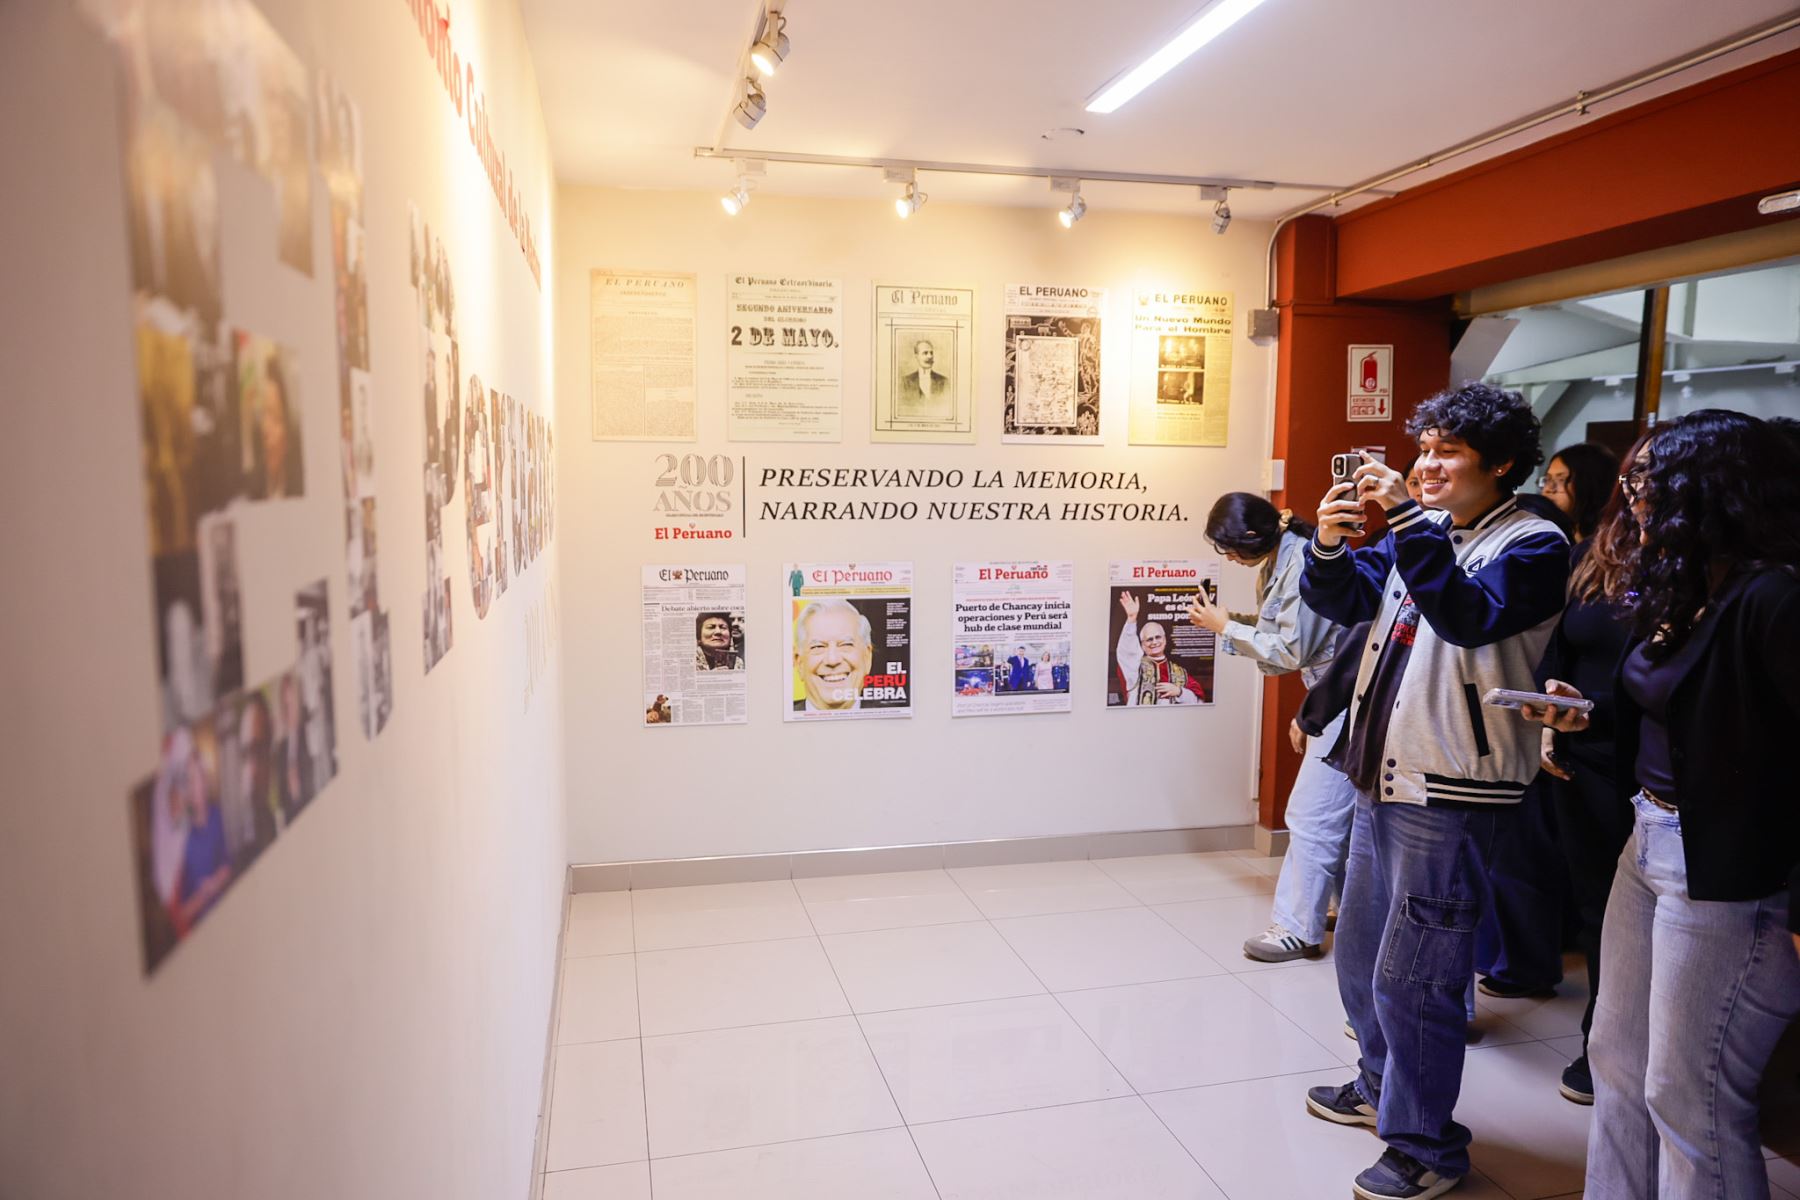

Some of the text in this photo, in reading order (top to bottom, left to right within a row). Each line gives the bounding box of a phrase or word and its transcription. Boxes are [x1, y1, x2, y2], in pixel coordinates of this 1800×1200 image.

[891, 289, 958, 306] El Peruano
[1019, 286, 1088, 298] EL PERUANO
[1154, 293, 1228, 306] EL PERUANO
[736, 303, 833, 314] SEGUNDO ANIVERSARIO
[1154, 315, 1189, 323] Nuevo
[1193, 316, 1232, 325] Mundo
[731, 325, 839, 349] 2 DE MAYO.
[1183, 326, 1231, 335] Hombre
[654, 453, 734, 487] 200
[758, 468, 1149, 494] PRESERVANDO LA MEMORIA,
[653, 485, 731, 512] AÑOS
[758, 501, 1189, 522] NARRANDO NUESTRA HISTORIA.
[655, 527, 733, 540] El Peruano
[659, 568, 729, 583] El Peruano
[812, 569, 893, 584] El Peruano
[979, 568, 1049, 580] El Peruano
[1133, 567, 1197, 578] El Peruano
[1147, 593, 1171, 604] Papa
[955, 601, 1071, 613] Puerto de Chancay inicia
[957, 611, 1069, 623] operaciones y Perú será
[1147, 612, 1173, 620] sumo
[964, 621, 1062, 632] hub de clase mundial
[886, 661, 907, 675] EL
[832, 686, 907, 701] CELEBRA
